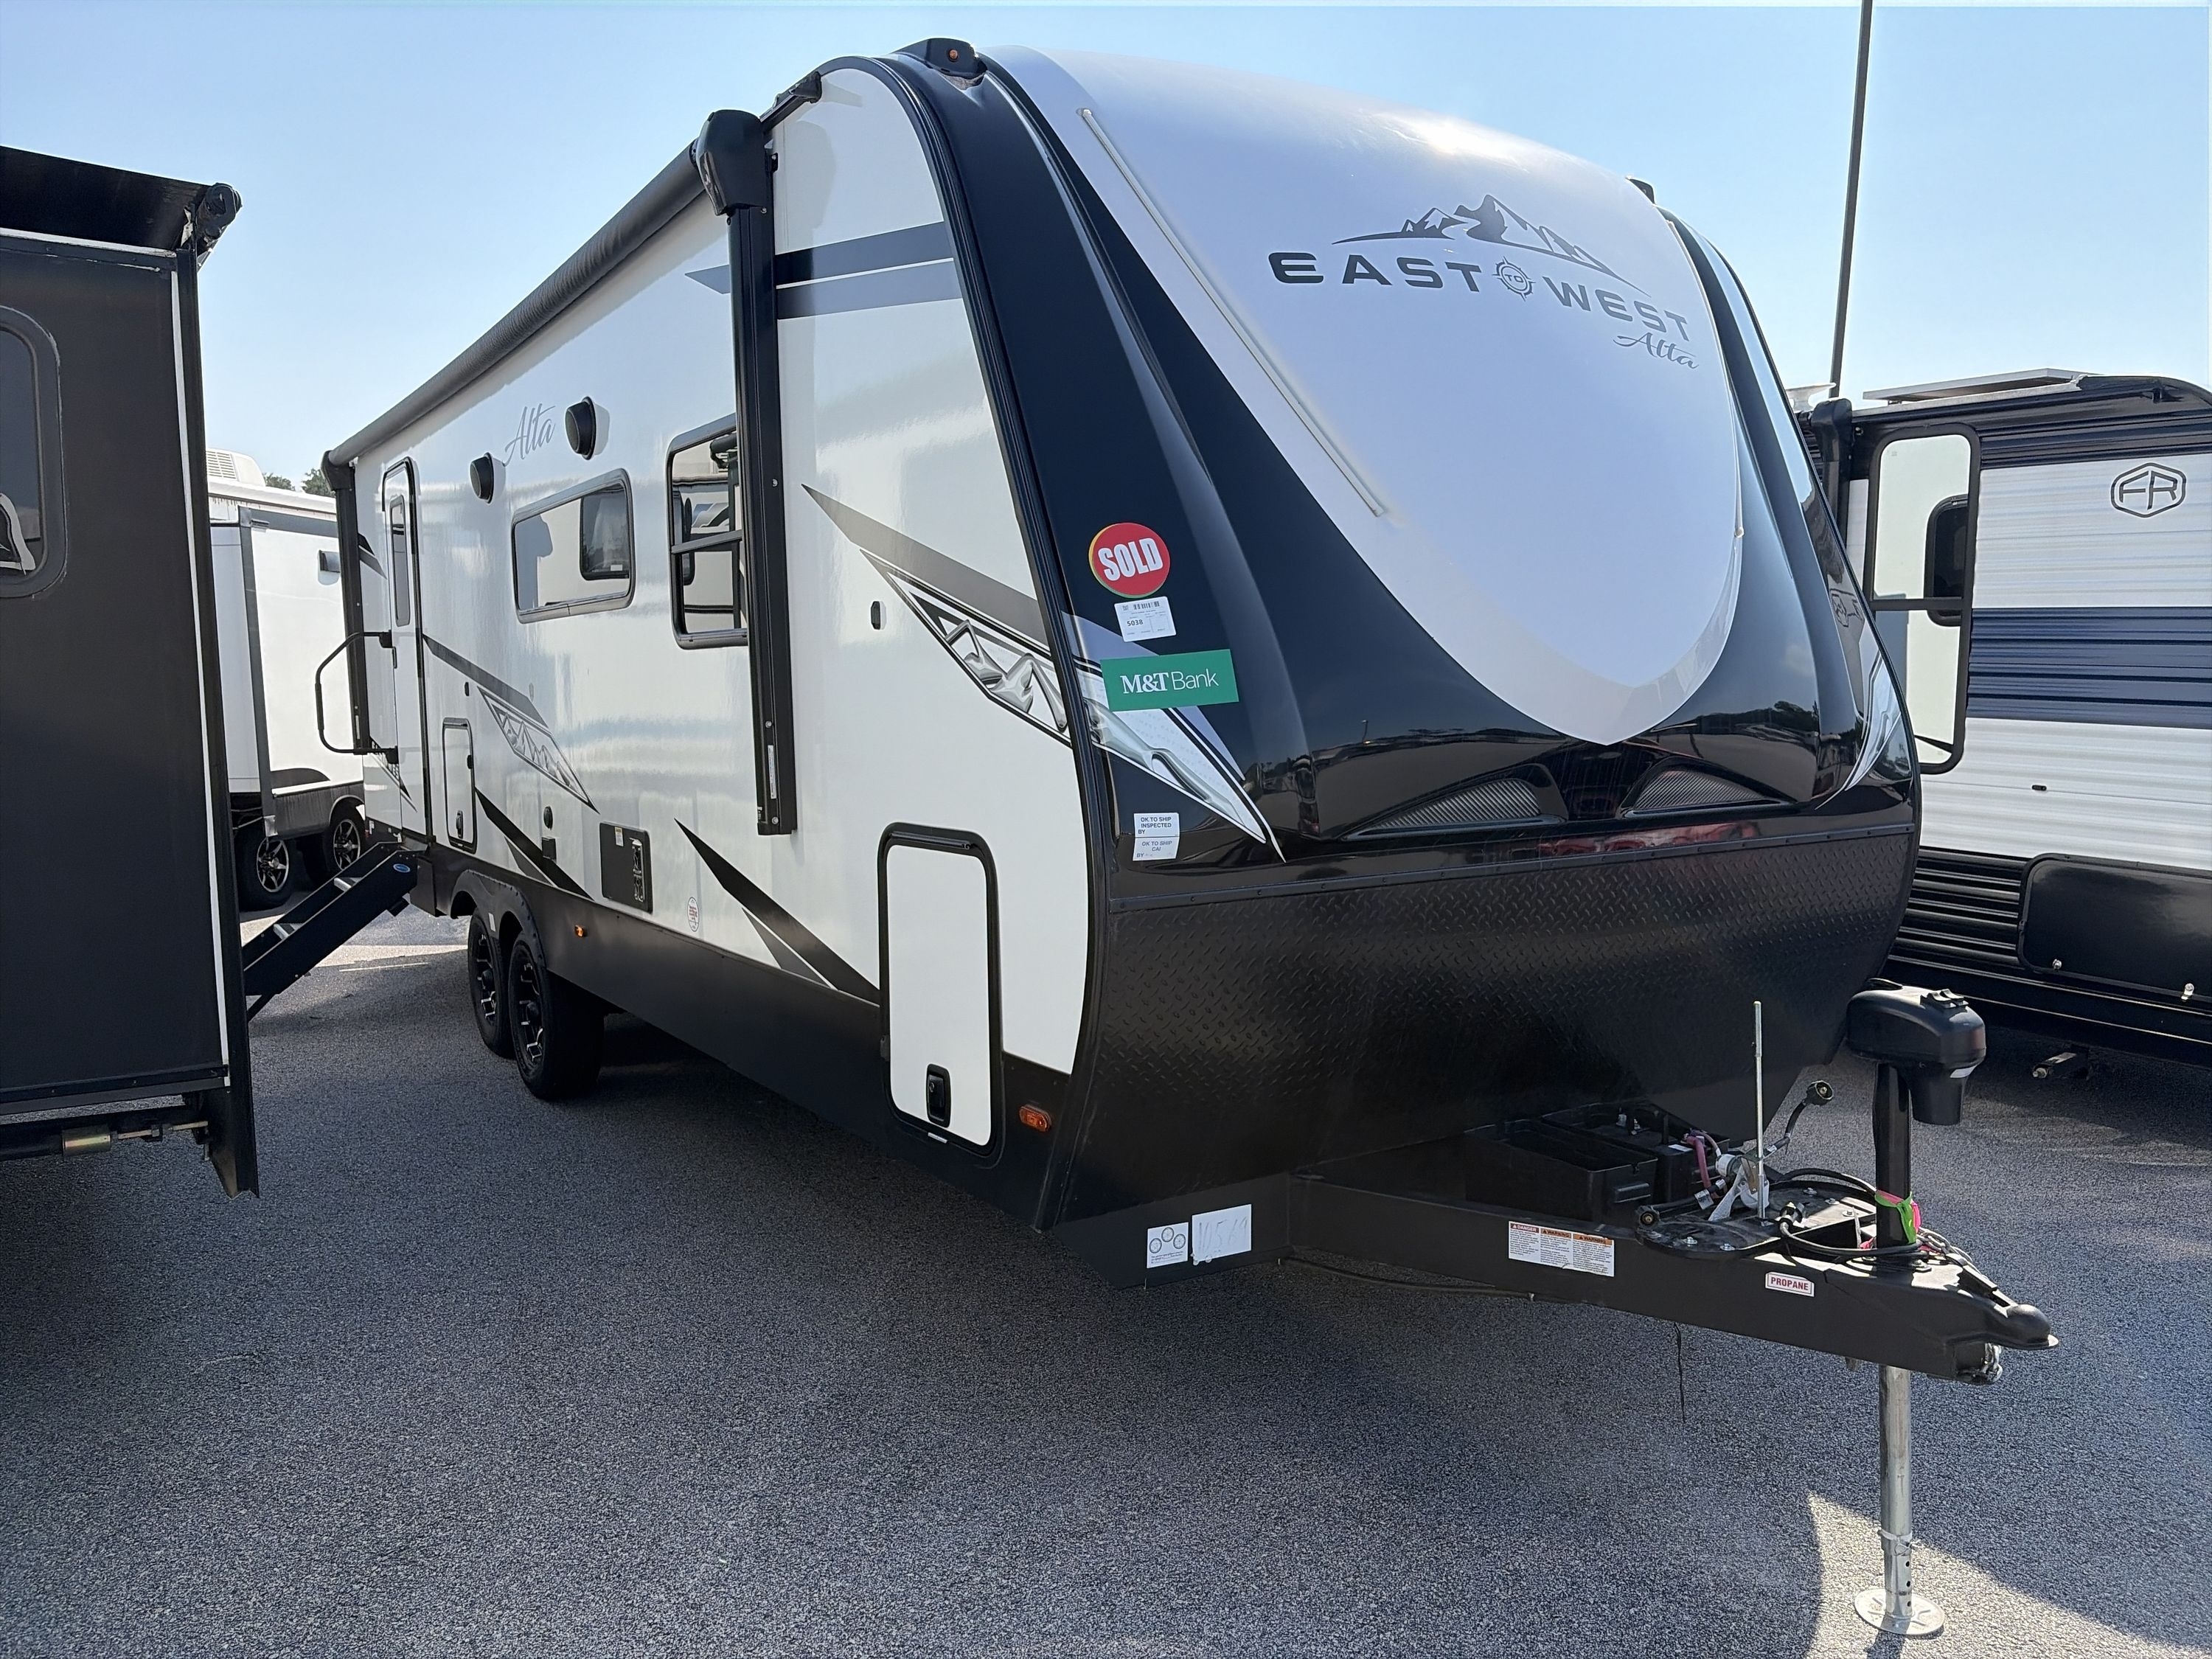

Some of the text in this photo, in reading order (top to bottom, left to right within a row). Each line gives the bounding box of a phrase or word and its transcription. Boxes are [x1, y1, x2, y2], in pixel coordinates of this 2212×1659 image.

[1268, 251, 1691, 341] EAST TO WEST
[1613, 332, 1700, 370] Alta
[504, 403, 556, 467] Alta
[1098, 538, 1164, 581] SOLD
[1127, 619, 1144, 627] 5038
[1120, 668, 1219, 694] M&T Bank
[1771, 1277, 1809, 1290] PROPANE
